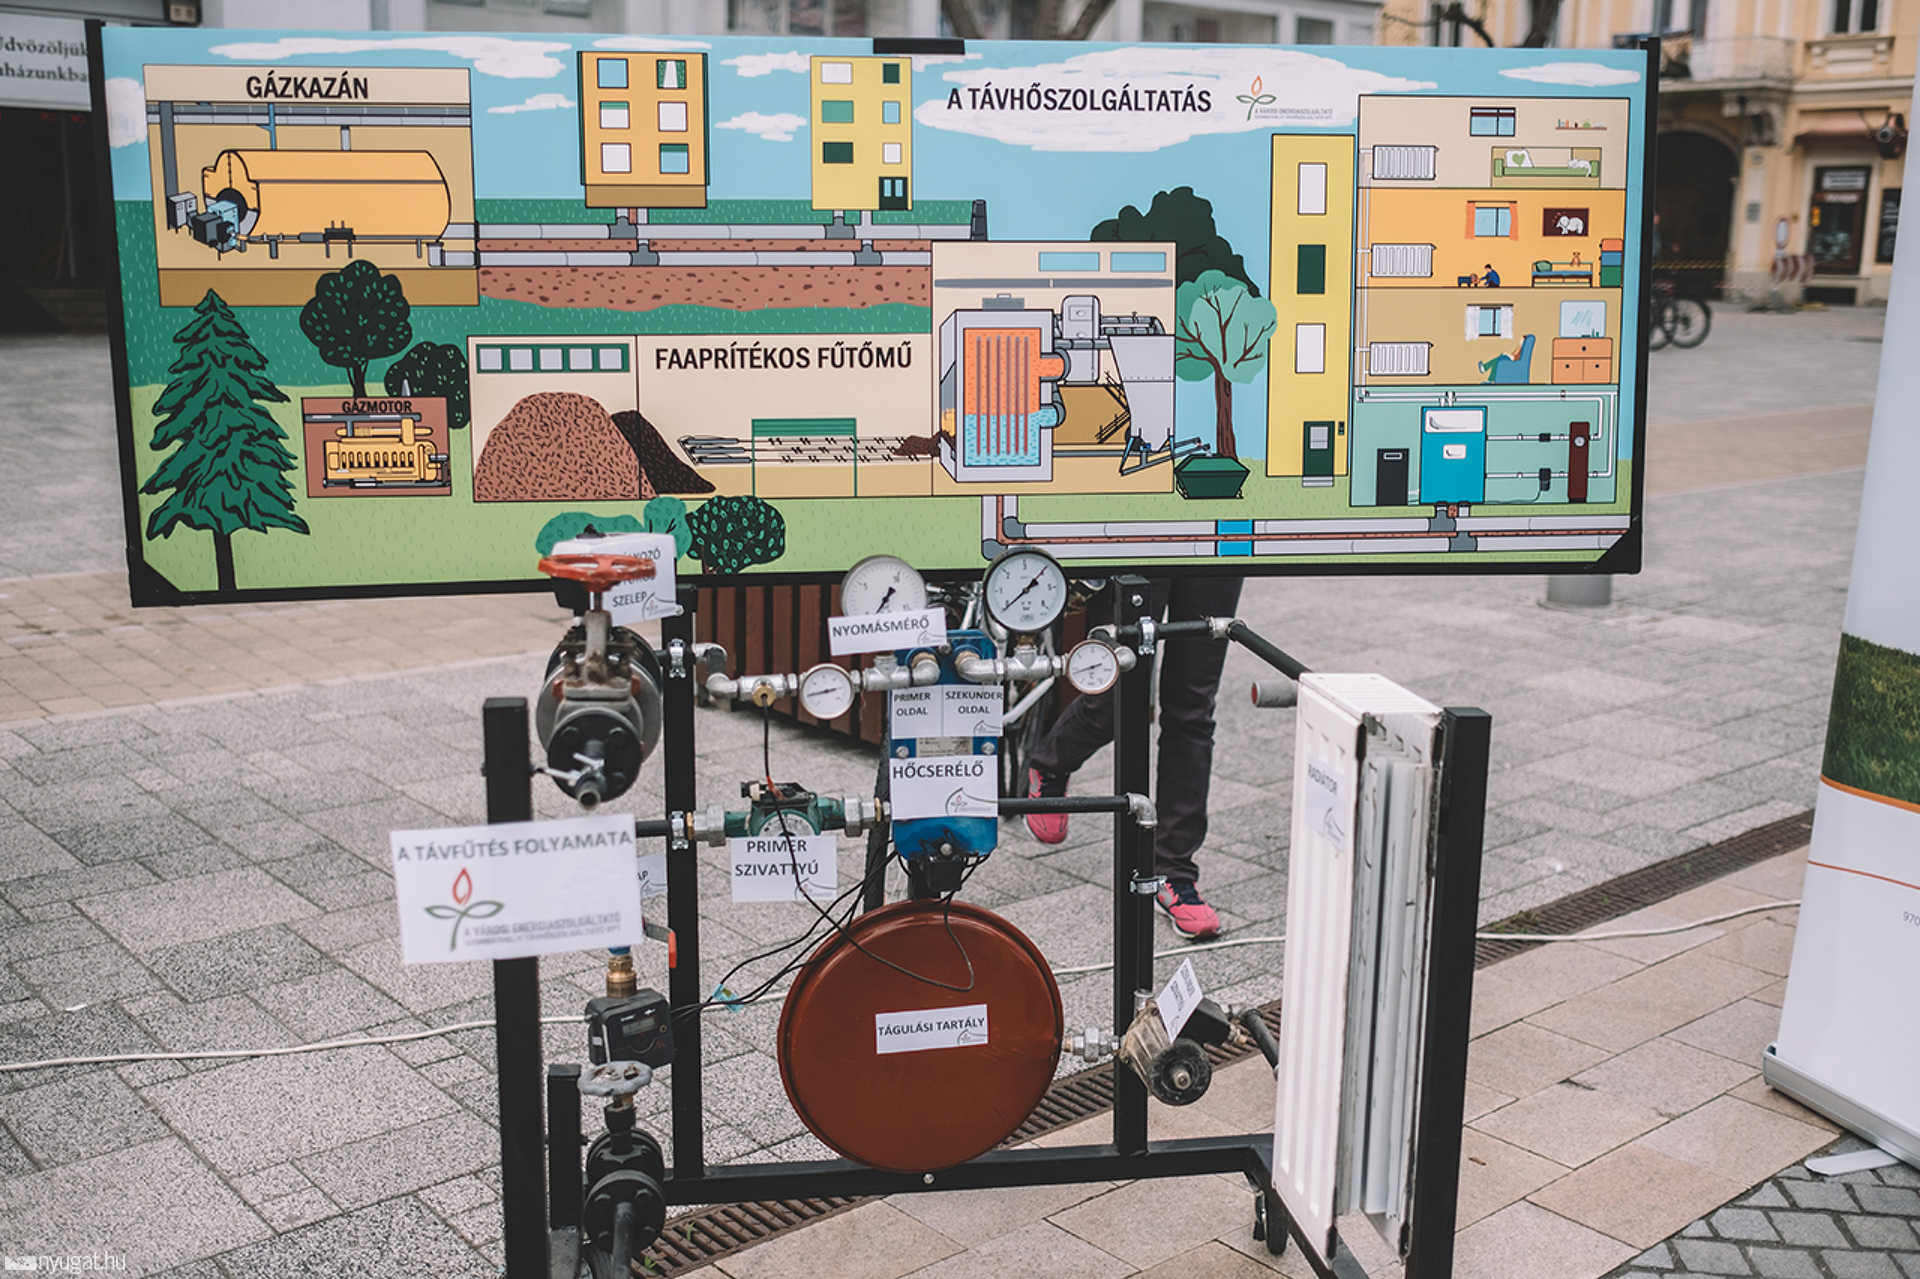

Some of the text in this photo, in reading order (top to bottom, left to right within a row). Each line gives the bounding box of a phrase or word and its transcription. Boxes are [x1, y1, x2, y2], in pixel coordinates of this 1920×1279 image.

[246, 70, 369, 100] GÁZKAZÁN
[947, 81, 1212, 113] A TÁVHŐSZOLGÁLTATÁS
[655, 339, 912, 370] FAAPRÍTÉKOS FŰTŐMŰ
[612, 591, 647, 607] SZELEP
[832, 615, 930, 637] NYOMÁSMÉRŐ
[893, 691, 931, 702] PRIMER
[945, 690, 1003, 700] SZEKUNDER
[896, 706, 928, 717] OLDAL
[958, 705, 990, 714] OLDAL
[893, 759, 984, 779] HŐCSERÉLŐ
[397, 830, 633, 861] A TÁVFŰTÉS FOLYAMATA
[747, 839, 807, 853] PRIMER
[735, 859, 819, 877] SZIVATTYÚ
[878, 1016, 985, 1037] TÁGULÁSI TARTÁLY
